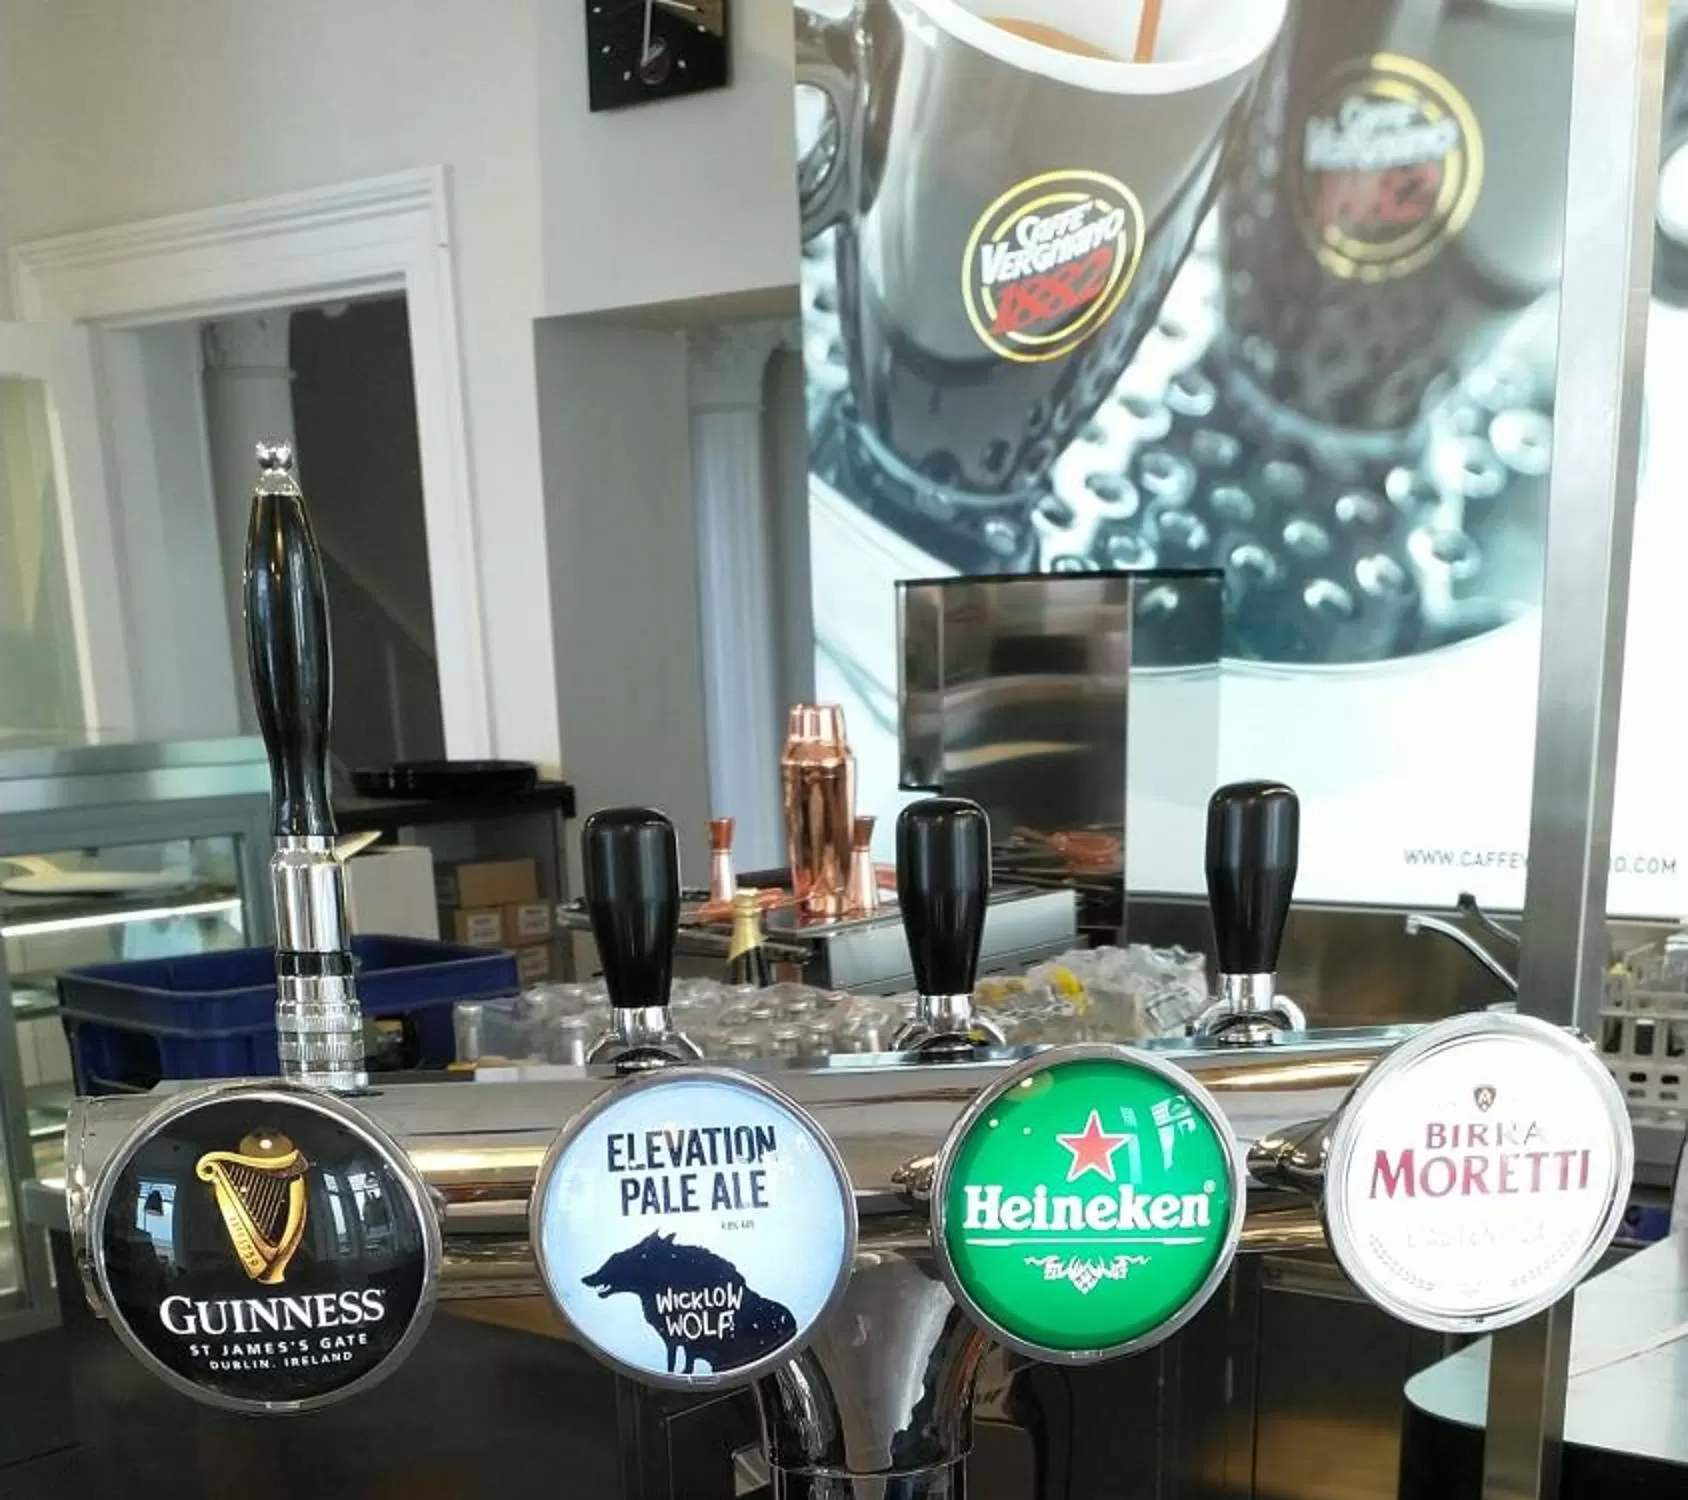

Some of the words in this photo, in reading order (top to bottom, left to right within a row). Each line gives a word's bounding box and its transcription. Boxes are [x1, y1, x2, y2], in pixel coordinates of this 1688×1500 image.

[606, 1125, 778, 1172] ELEVATION
[1425, 1120, 1545, 1149] BIRRA
[621, 1174, 701, 1217] PALE
[711, 1170, 769, 1211] ALE
[1369, 1149, 1592, 1200] MORETTI
[963, 1184, 1211, 1231] Heineken
[159, 1290, 384, 1335] GUINNESS
[655, 1281, 743, 1315] WICKLOW
[665, 1309, 735, 1340] WOLF
[189, 1344, 210, 1358] ST
[222, 1340, 309, 1356] JAMES'S
[320, 1333, 368, 1349] GATE
[284, 1351, 353, 1368] IRELAND
